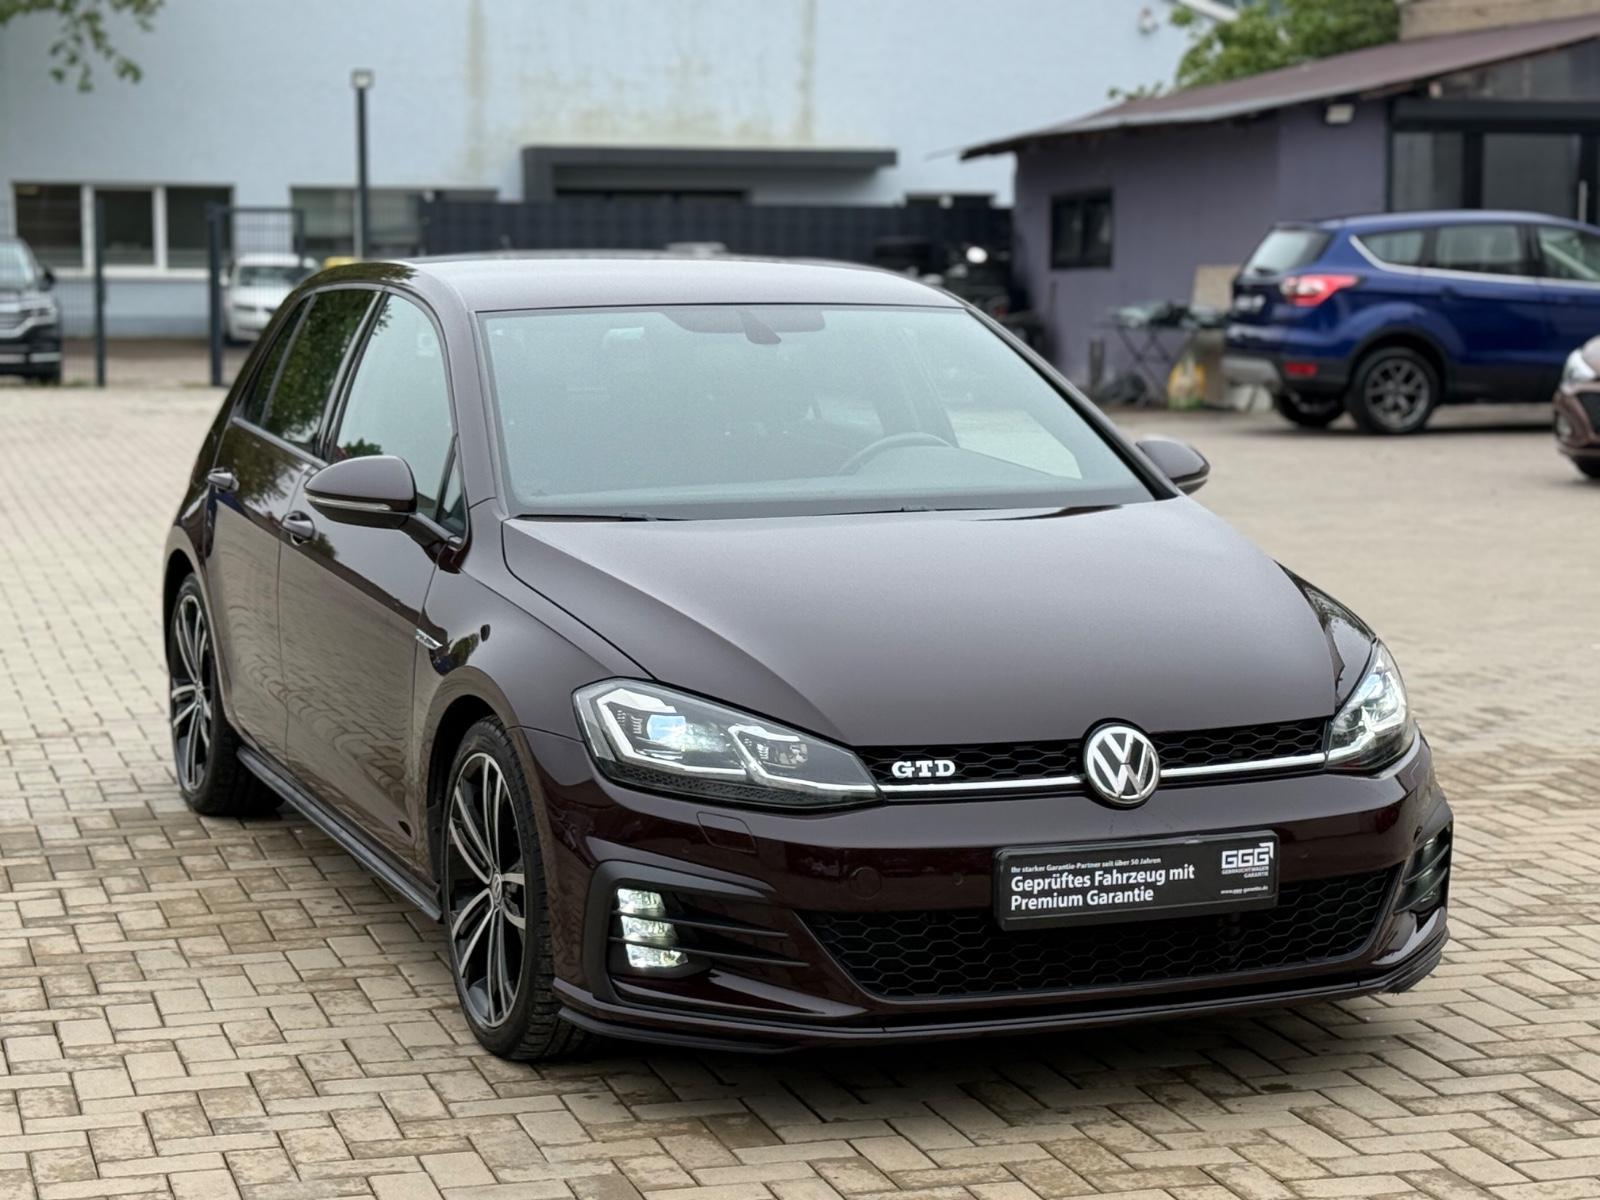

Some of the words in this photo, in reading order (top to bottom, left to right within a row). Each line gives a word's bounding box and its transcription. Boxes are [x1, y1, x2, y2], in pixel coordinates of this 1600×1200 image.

[891, 760, 956, 778] GTD
[1022, 865, 1045, 873] starker
[1131, 858, 1139, 866] 50
[1140, 857, 1162, 865] Jahren
[1221, 847, 1270, 869] GGG
[1011, 872, 1091, 894] Geprüftes
[1094, 869, 1166, 886] Fahrzeug
[1169, 863, 1195, 881] mit
[1011, 892, 1083, 910] Premium
[1087, 886, 1154, 905] Garantie
